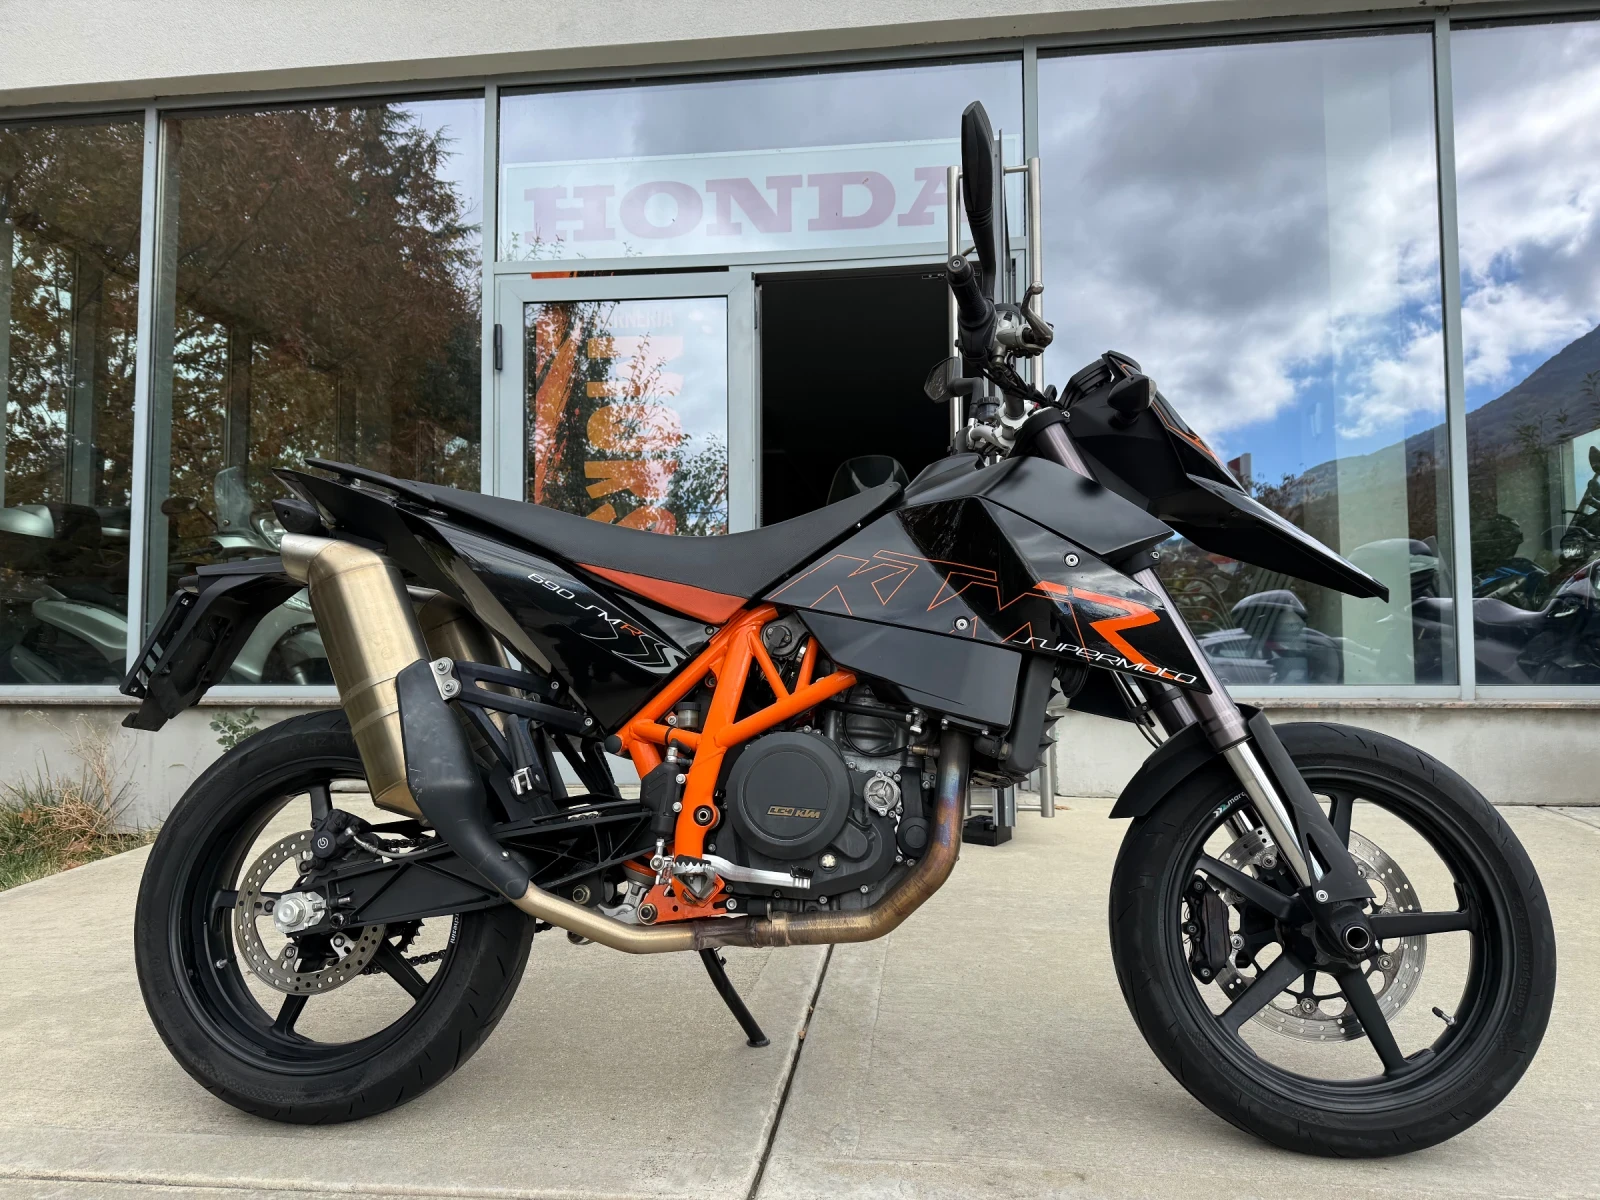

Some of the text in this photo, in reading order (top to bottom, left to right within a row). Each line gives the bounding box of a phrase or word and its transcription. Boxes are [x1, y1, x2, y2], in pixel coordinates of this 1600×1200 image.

[523, 164, 970, 244] HONDA
[527, 572, 576, 600] 690
[1011, 635, 1198, 684] SUPERMOTO
[794, 808, 820, 818] KTM
